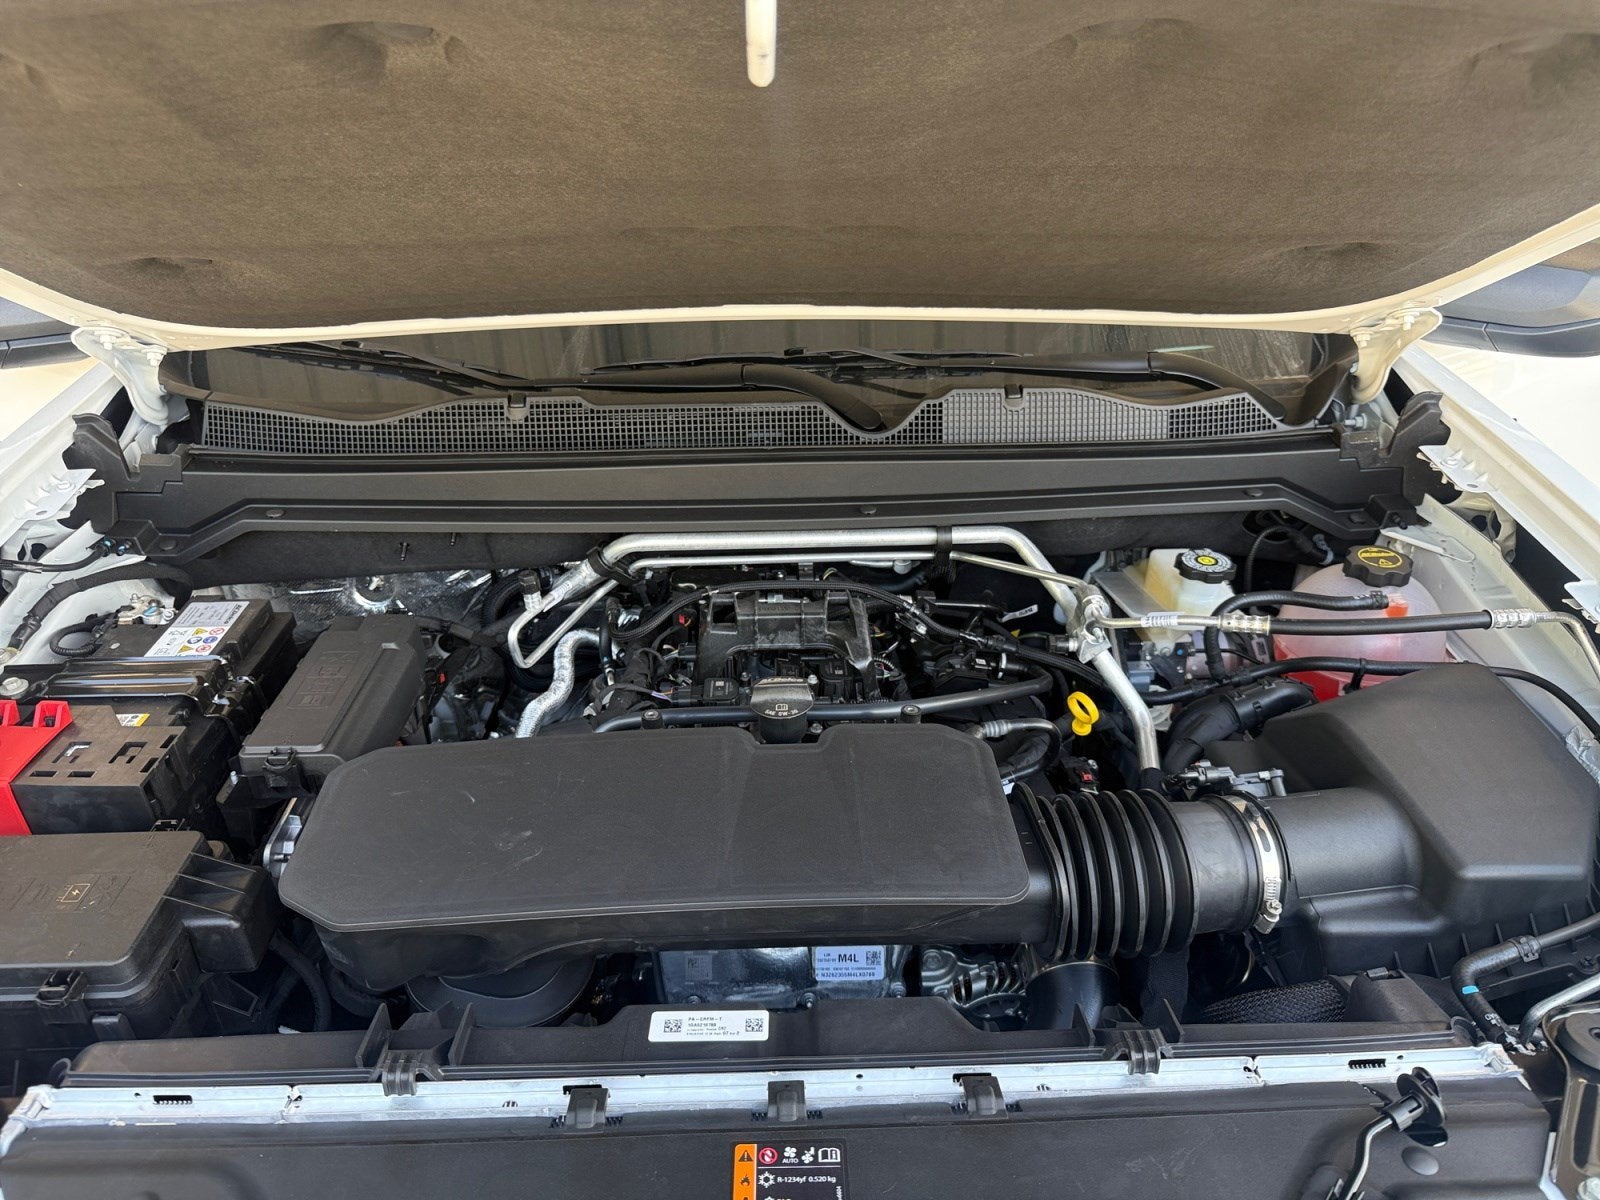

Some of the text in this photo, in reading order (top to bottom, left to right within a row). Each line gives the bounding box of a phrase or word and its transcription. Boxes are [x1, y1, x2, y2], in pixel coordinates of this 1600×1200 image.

[838, 953, 860, 963] M4L
[776, 1176, 807, 1185] R-1234yf
[827, 1175, 837, 1184] kg
